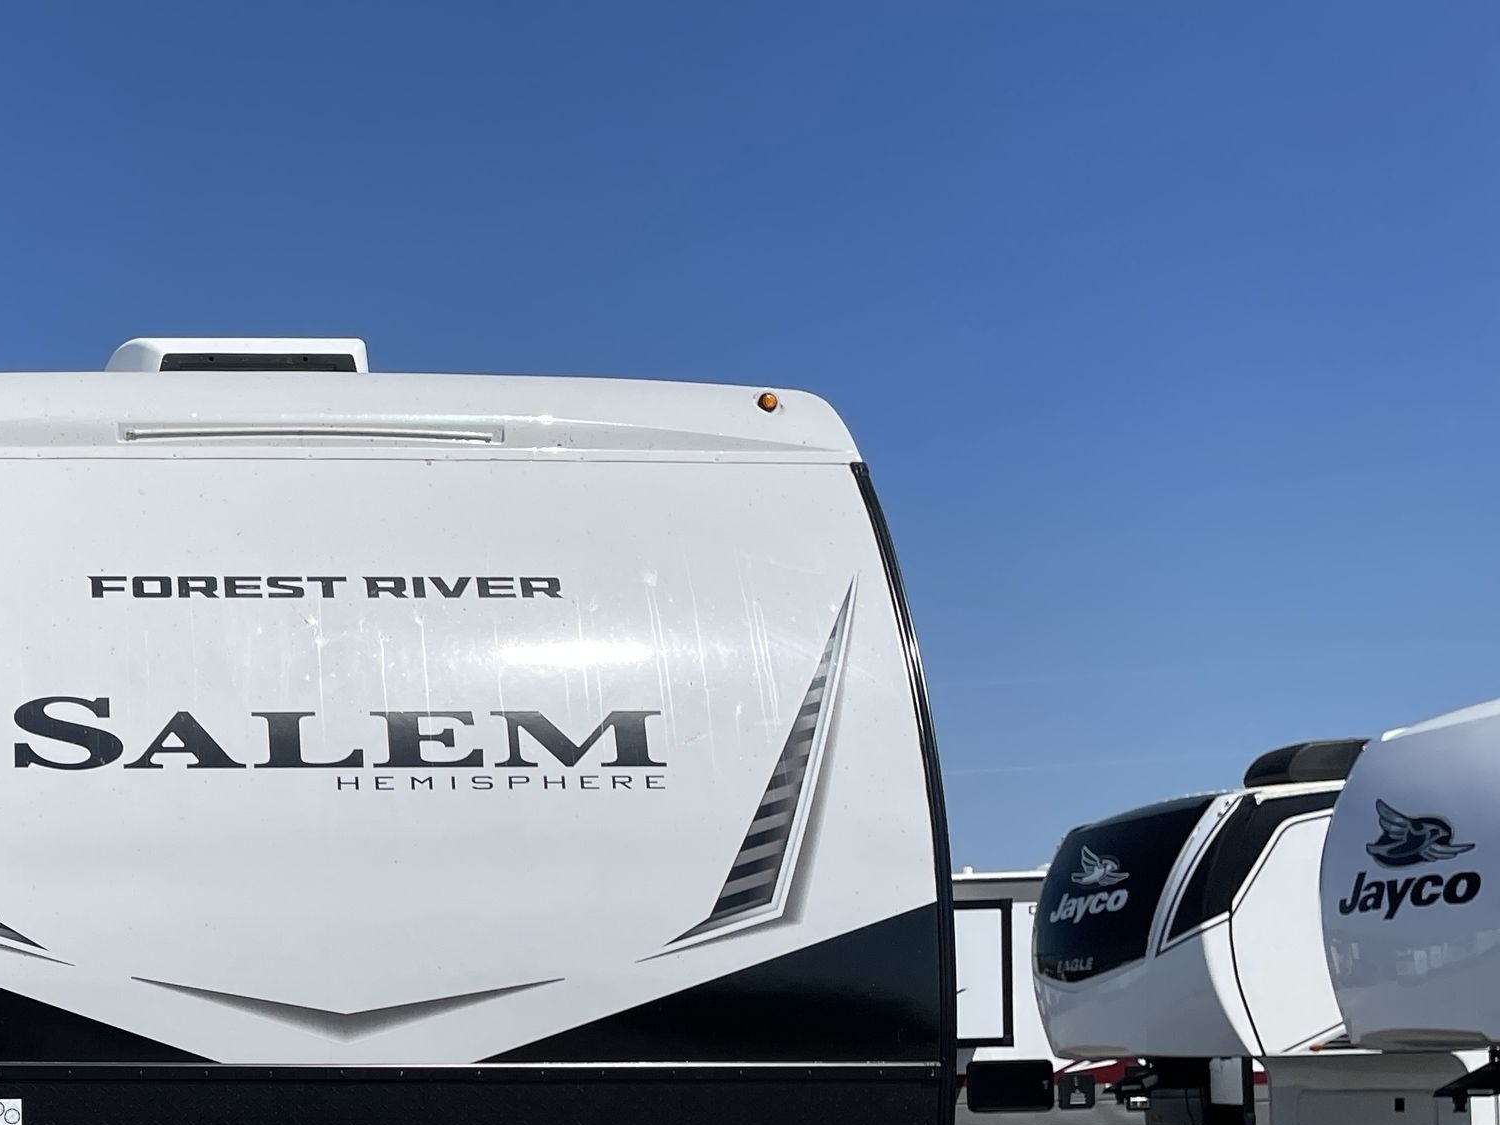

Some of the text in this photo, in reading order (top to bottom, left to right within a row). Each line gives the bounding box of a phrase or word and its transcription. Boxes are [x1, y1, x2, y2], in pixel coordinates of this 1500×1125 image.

[87, 576, 564, 599] FOREST RIVER
[13, 696, 667, 770] SALEM
[337, 775, 667, 791] HEMISPHERE
[1049, 888, 1129, 924] Jayco
[1339, 871, 1481, 921] Jayco
[1056, 956, 1094, 974] EAGLE
